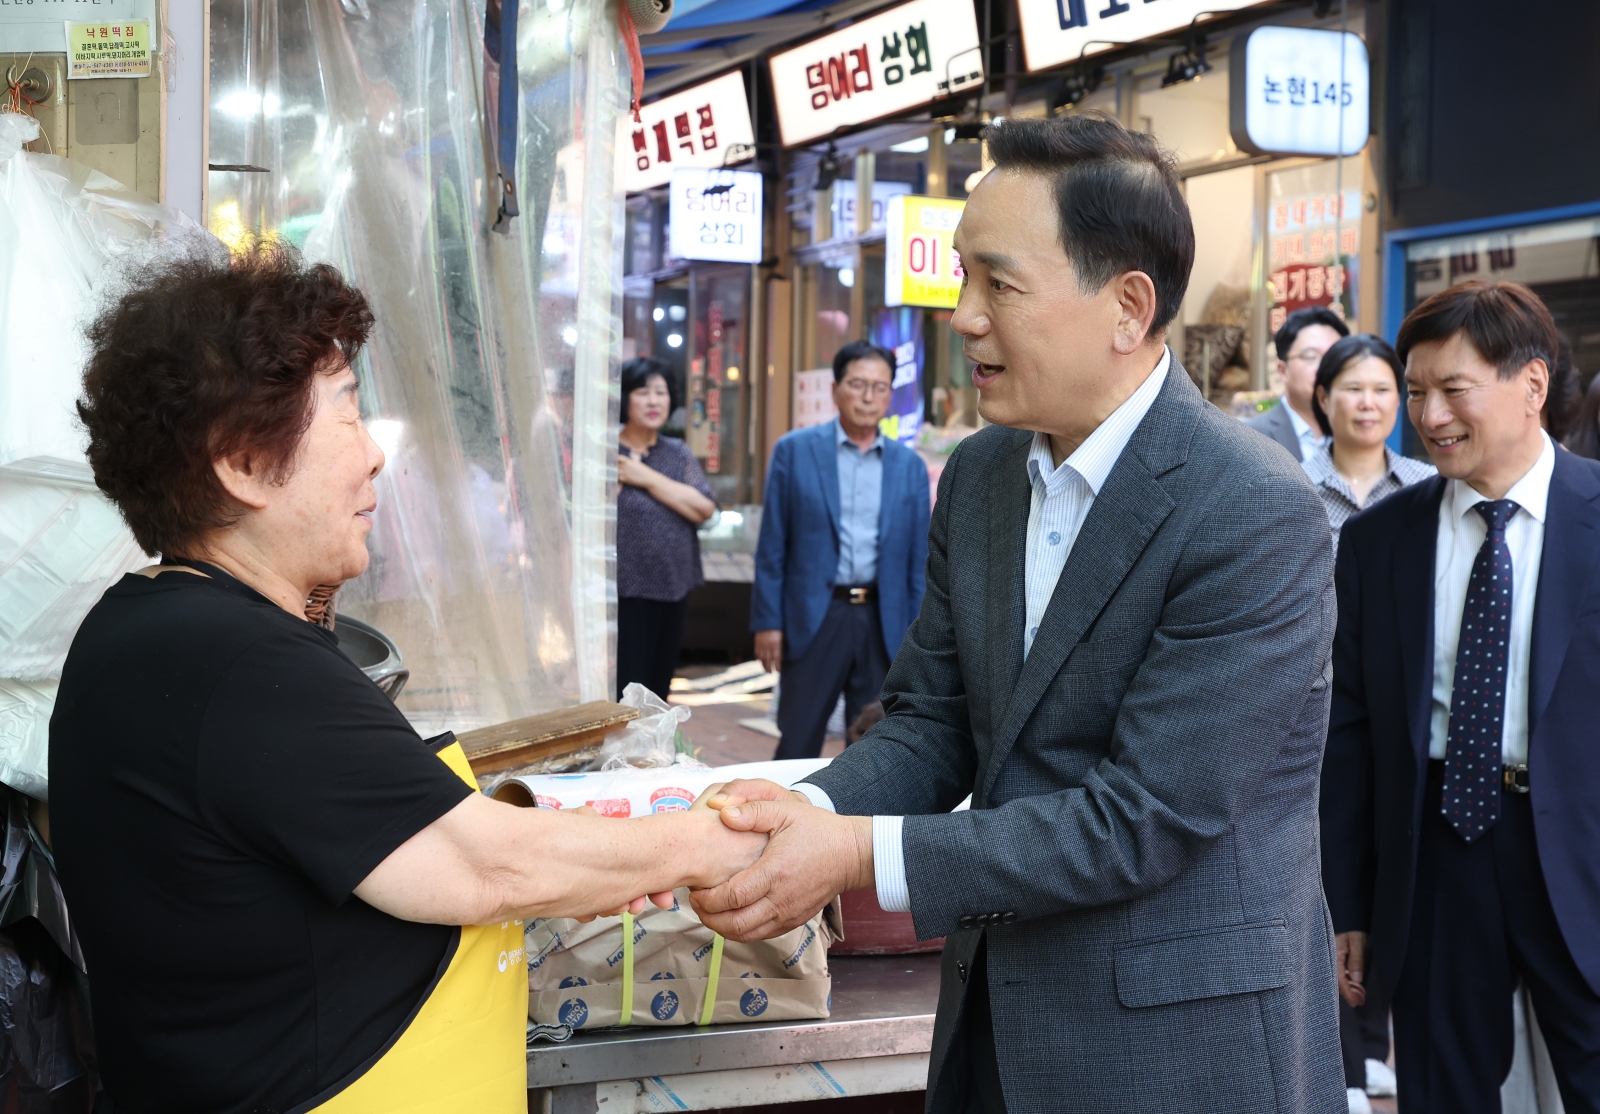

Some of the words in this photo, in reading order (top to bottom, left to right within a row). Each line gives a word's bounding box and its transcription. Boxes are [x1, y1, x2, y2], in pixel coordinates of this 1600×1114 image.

[805, 43, 874, 111] 덩어리
[880, 21, 932, 86] 상회
[1263, 74, 1353, 107] 논현145
[699, 222, 744, 245] 상회
[783, 929, 817, 970] MOORIM
[565, 1005, 580, 1022] neo
[657, 997, 673, 1014] neo
[659, 999, 678, 1020] STAR
[745, 995, 762, 1011] neo
[747, 997, 768, 1016] STAR
